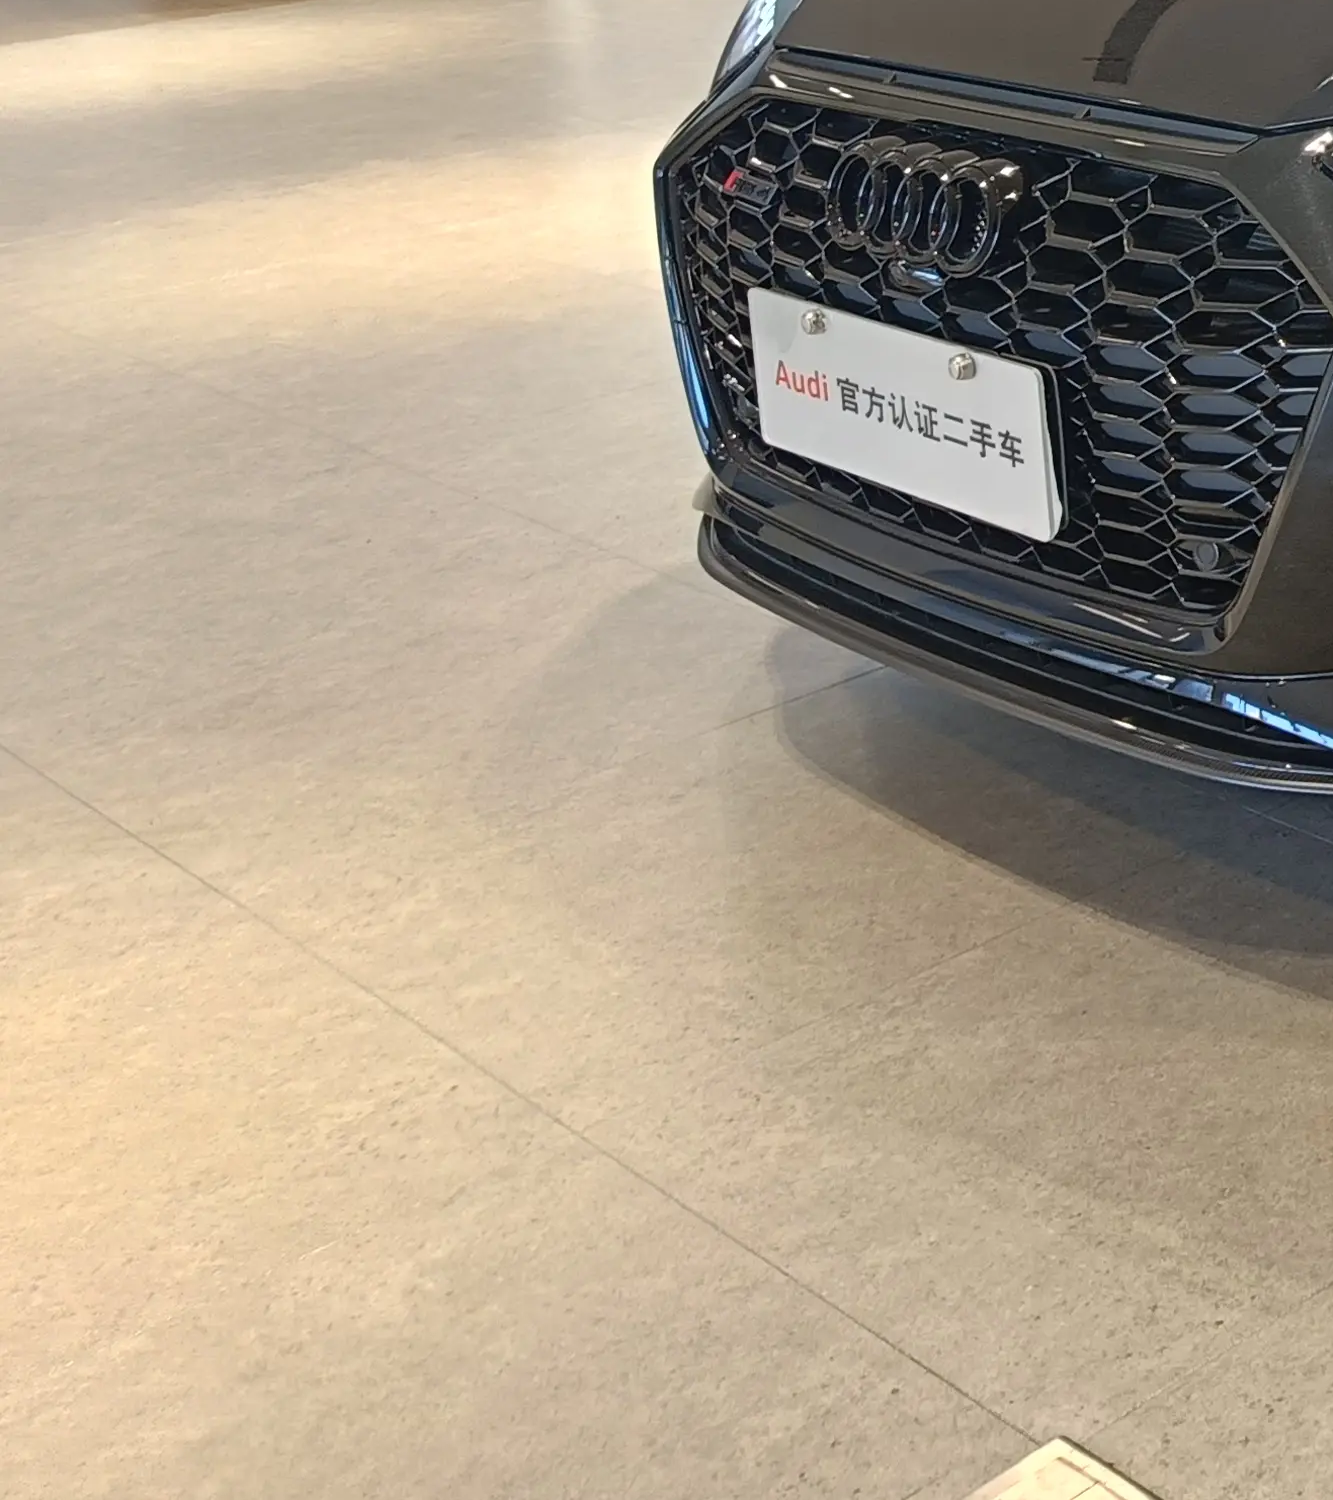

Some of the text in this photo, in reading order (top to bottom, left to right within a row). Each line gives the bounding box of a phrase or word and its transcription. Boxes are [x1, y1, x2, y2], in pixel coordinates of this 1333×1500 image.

[775, 359, 1025, 468] Audi 官方认证二手车
